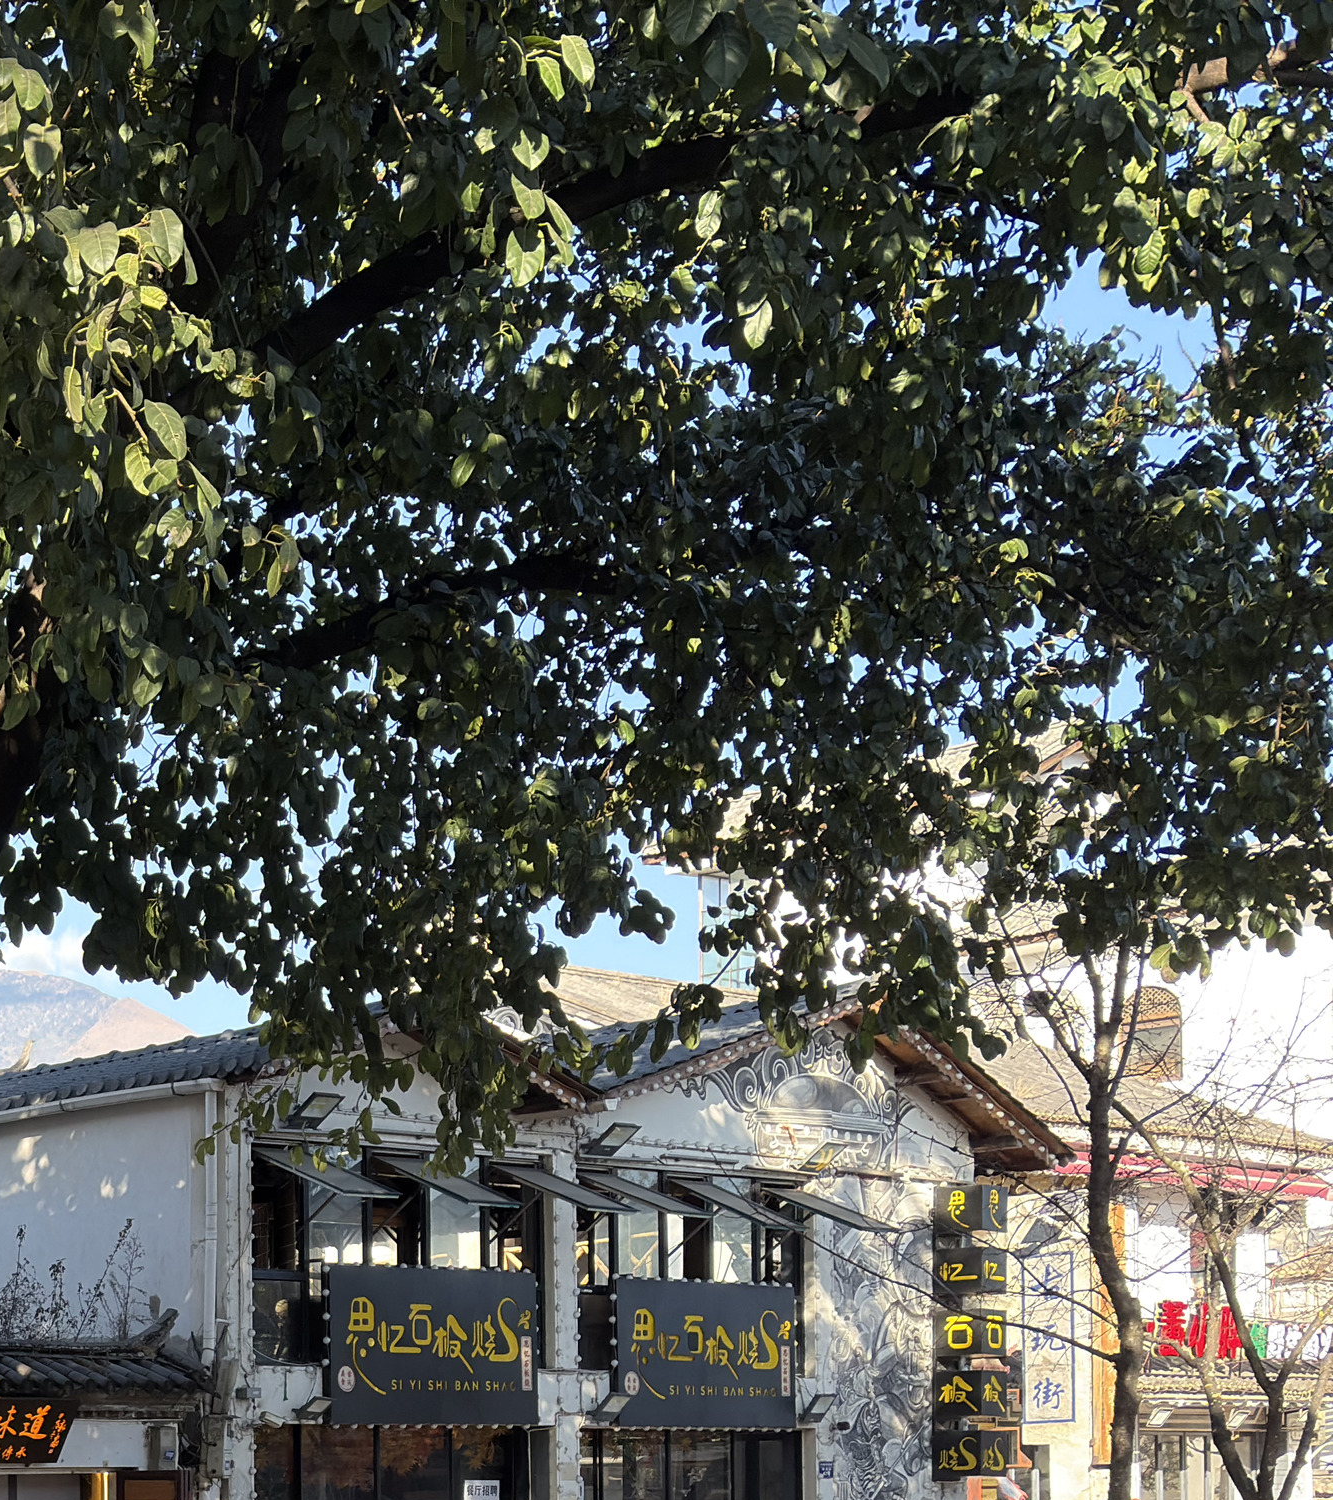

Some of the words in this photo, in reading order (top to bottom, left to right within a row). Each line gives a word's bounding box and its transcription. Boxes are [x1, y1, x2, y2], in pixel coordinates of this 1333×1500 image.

[391, 1379, 403, 1391] SI
[409, 1379, 421, 1391] YI
[428, 1380, 448, 1391] SHI
[455, 1380, 479, 1391] BAN
[669, 1385, 680, 1395] SI
[685, 1385, 695, 1395] YI
[700, 1386, 718, 1396] SHI
[723, 1386, 744, 1396] BAN
[466, 1484, 498, 1497] 餐厅招聘
